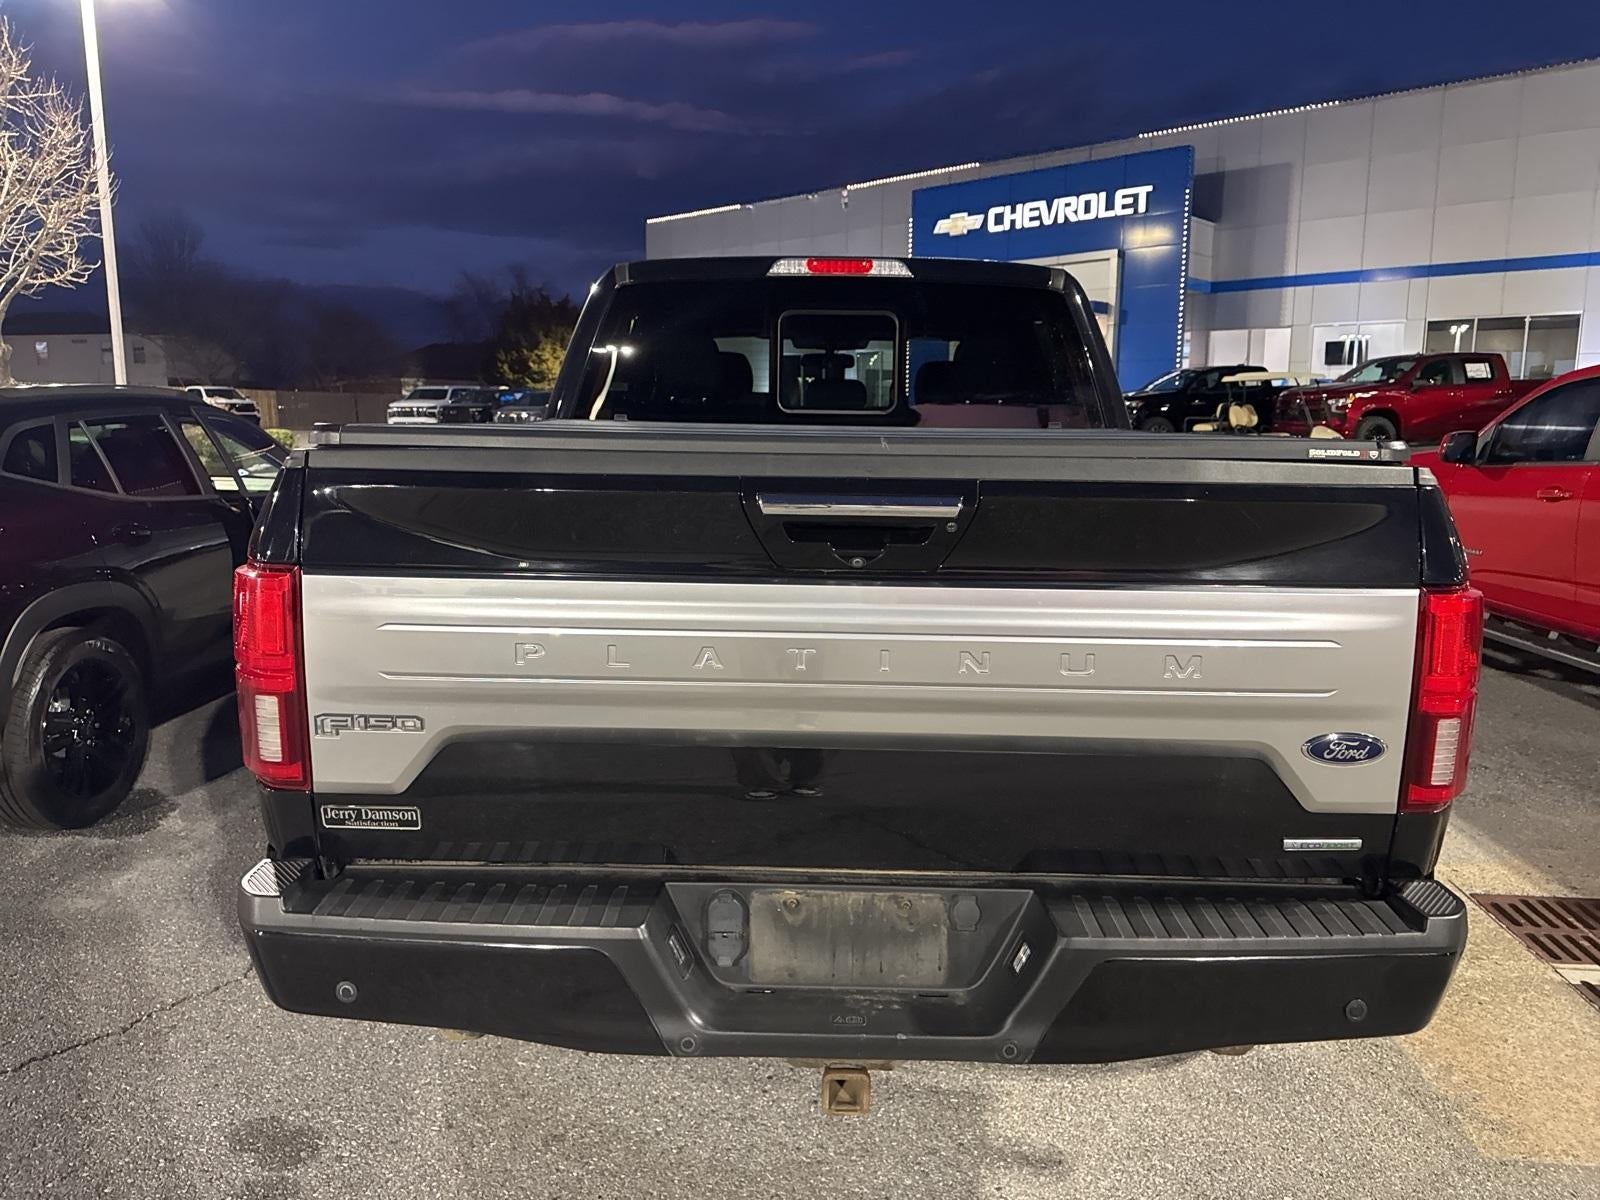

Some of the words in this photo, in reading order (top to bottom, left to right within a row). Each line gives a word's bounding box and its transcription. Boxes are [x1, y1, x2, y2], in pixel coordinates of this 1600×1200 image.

[987, 184, 1154, 233] CHEVROLET
[514, 641, 1203, 679] PLATINUM
[1323, 740, 1371, 760] Ford
[325, 807, 358, 822] Jerry
[361, 808, 417, 821] Damson
